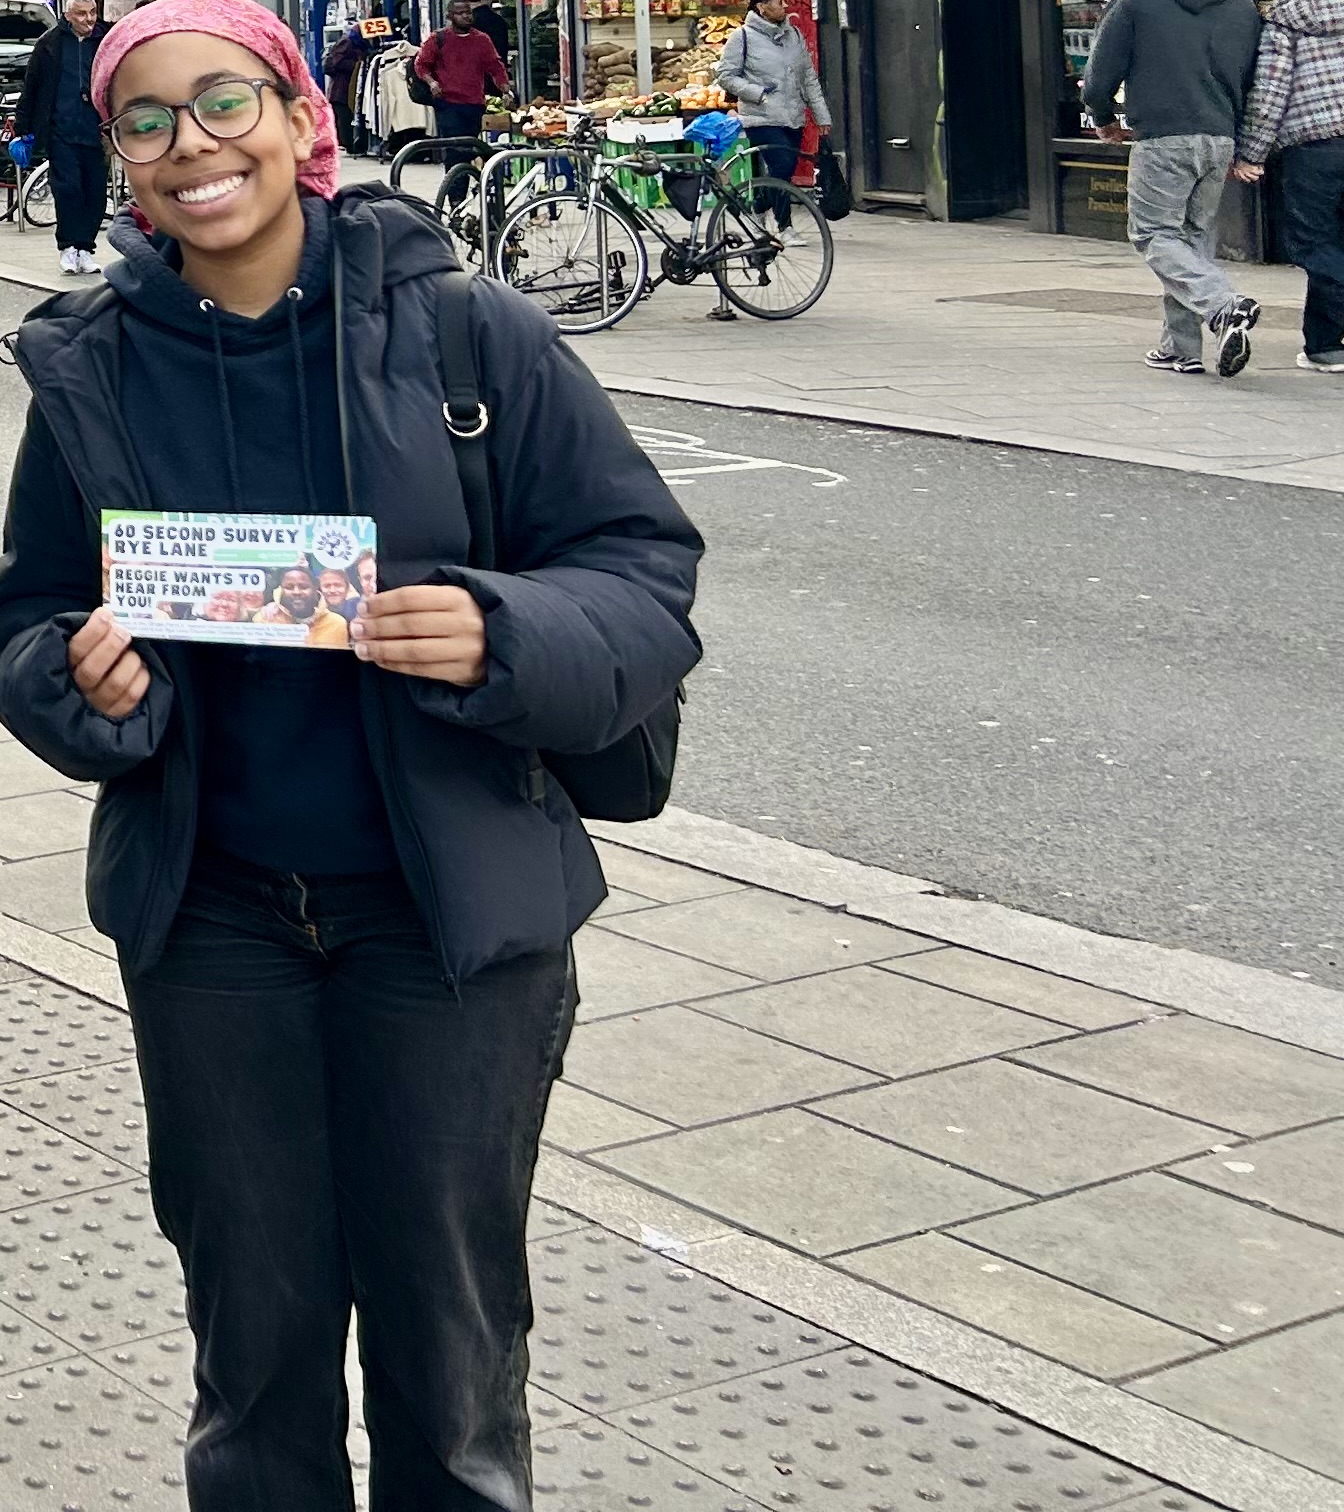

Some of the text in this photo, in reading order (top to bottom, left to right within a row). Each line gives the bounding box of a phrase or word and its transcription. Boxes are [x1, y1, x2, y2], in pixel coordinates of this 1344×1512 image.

[364, 20, 387, 35] £5
[115, 524, 299, 544] 60 SECOND SURVEY
[115, 540, 208, 557] RYE LANE
[115, 569, 260, 586] REGGIE WANTS TO
[115, 582, 206, 597] HEAR FROM
[116, 595, 152, 608] YOU!
